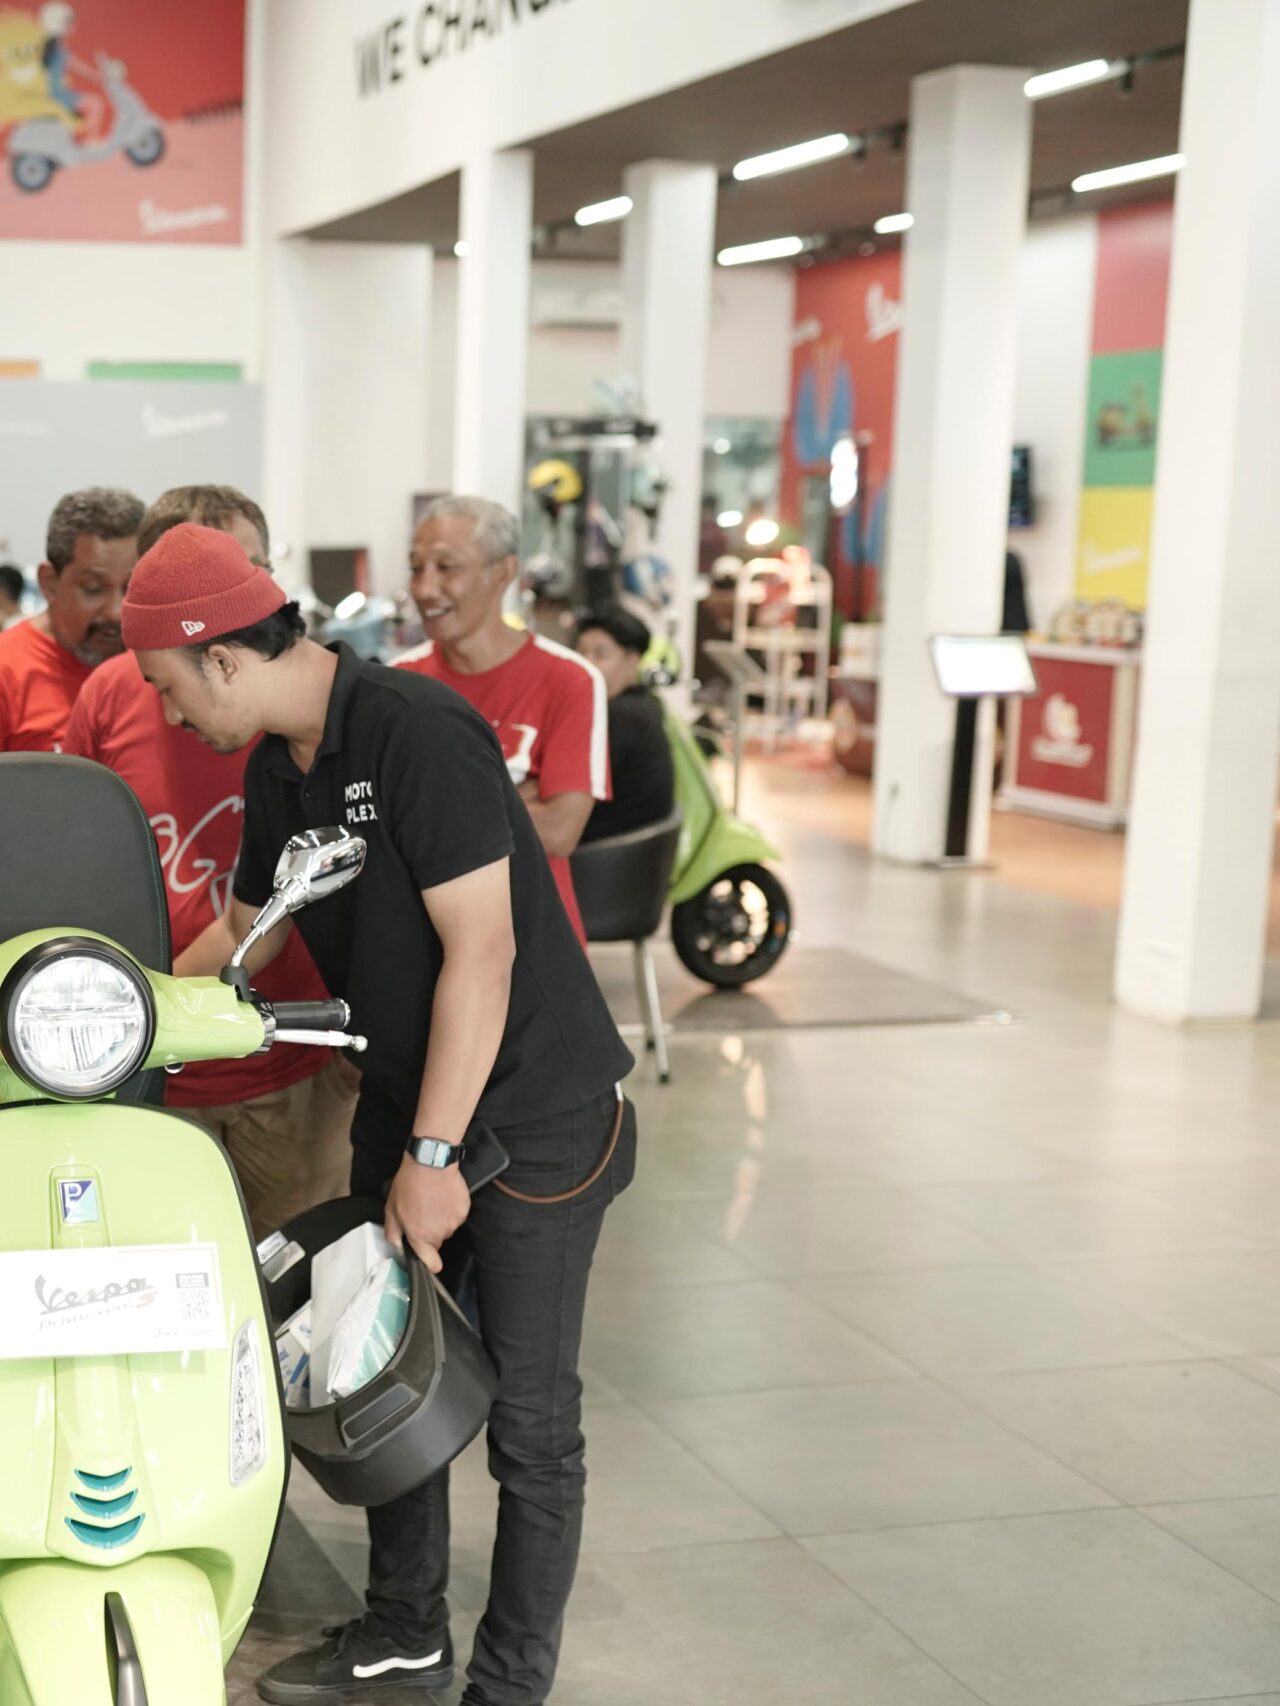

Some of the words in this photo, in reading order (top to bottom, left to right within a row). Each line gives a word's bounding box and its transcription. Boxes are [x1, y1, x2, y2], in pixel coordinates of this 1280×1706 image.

[353, 14, 408, 102] WE
[413, 0, 552, 66] CHAN
[346, 803, 378, 825] PLEX
[35, 1274, 157, 1316] Vespa
